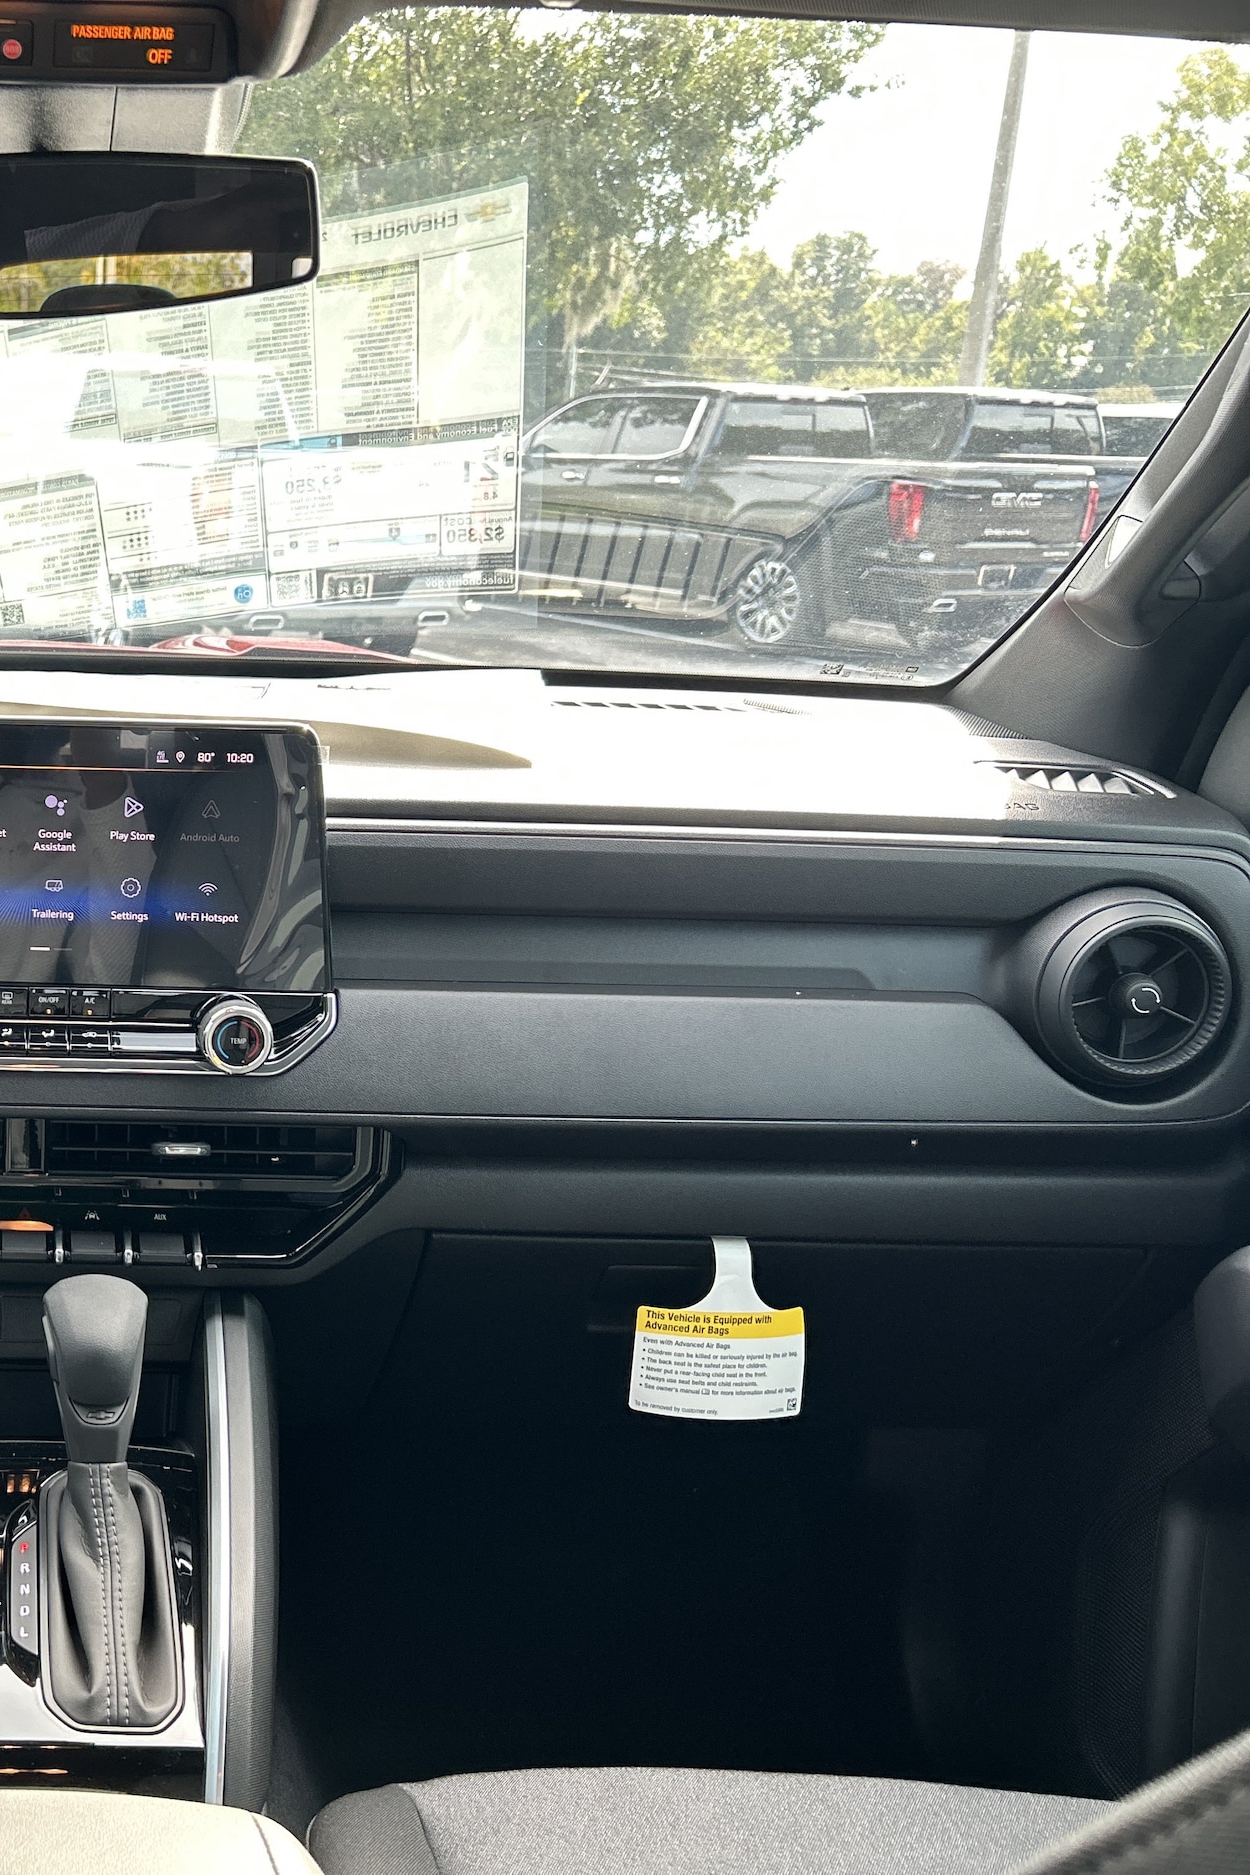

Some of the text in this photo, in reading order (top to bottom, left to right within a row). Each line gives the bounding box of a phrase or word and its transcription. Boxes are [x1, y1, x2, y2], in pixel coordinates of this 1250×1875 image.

[71, 25, 174, 40] PASSENGER AIR BAG
[147, 48, 172, 64] OFF
[991, 492, 1043, 509] GMC
[197, 752, 215, 762] 80°
[226, 752, 254, 763] 10:20
[38, 829, 72, 841] Google
[110, 831, 155, 842] Play Store
[180, 832, 239, 843] Android Auto
[33, 842, 76, 852] Assistant
[32, 908, 74, 921] Trailering
[110, 910, 148, 922] Settings
[175, 912, 238, 924] Wi-Fi Hotspot
[646, 1310, 772, 1326] This Vehicle is Equipped with
[645, 1320, 729, 1336] Advanced Air Bags
[648, 1348, 672, 1356] Children
[645, 1374, 665, 1382] Always
[650, 1403, 672, 1411] removed
[20, 1542, 29, 1554] P
[20, 1562, 30, 1574] R
[20, 1584, 30, 1595] N
[20, 1605, 30, 1616] D
[20, 1626, 28, 1637] L
